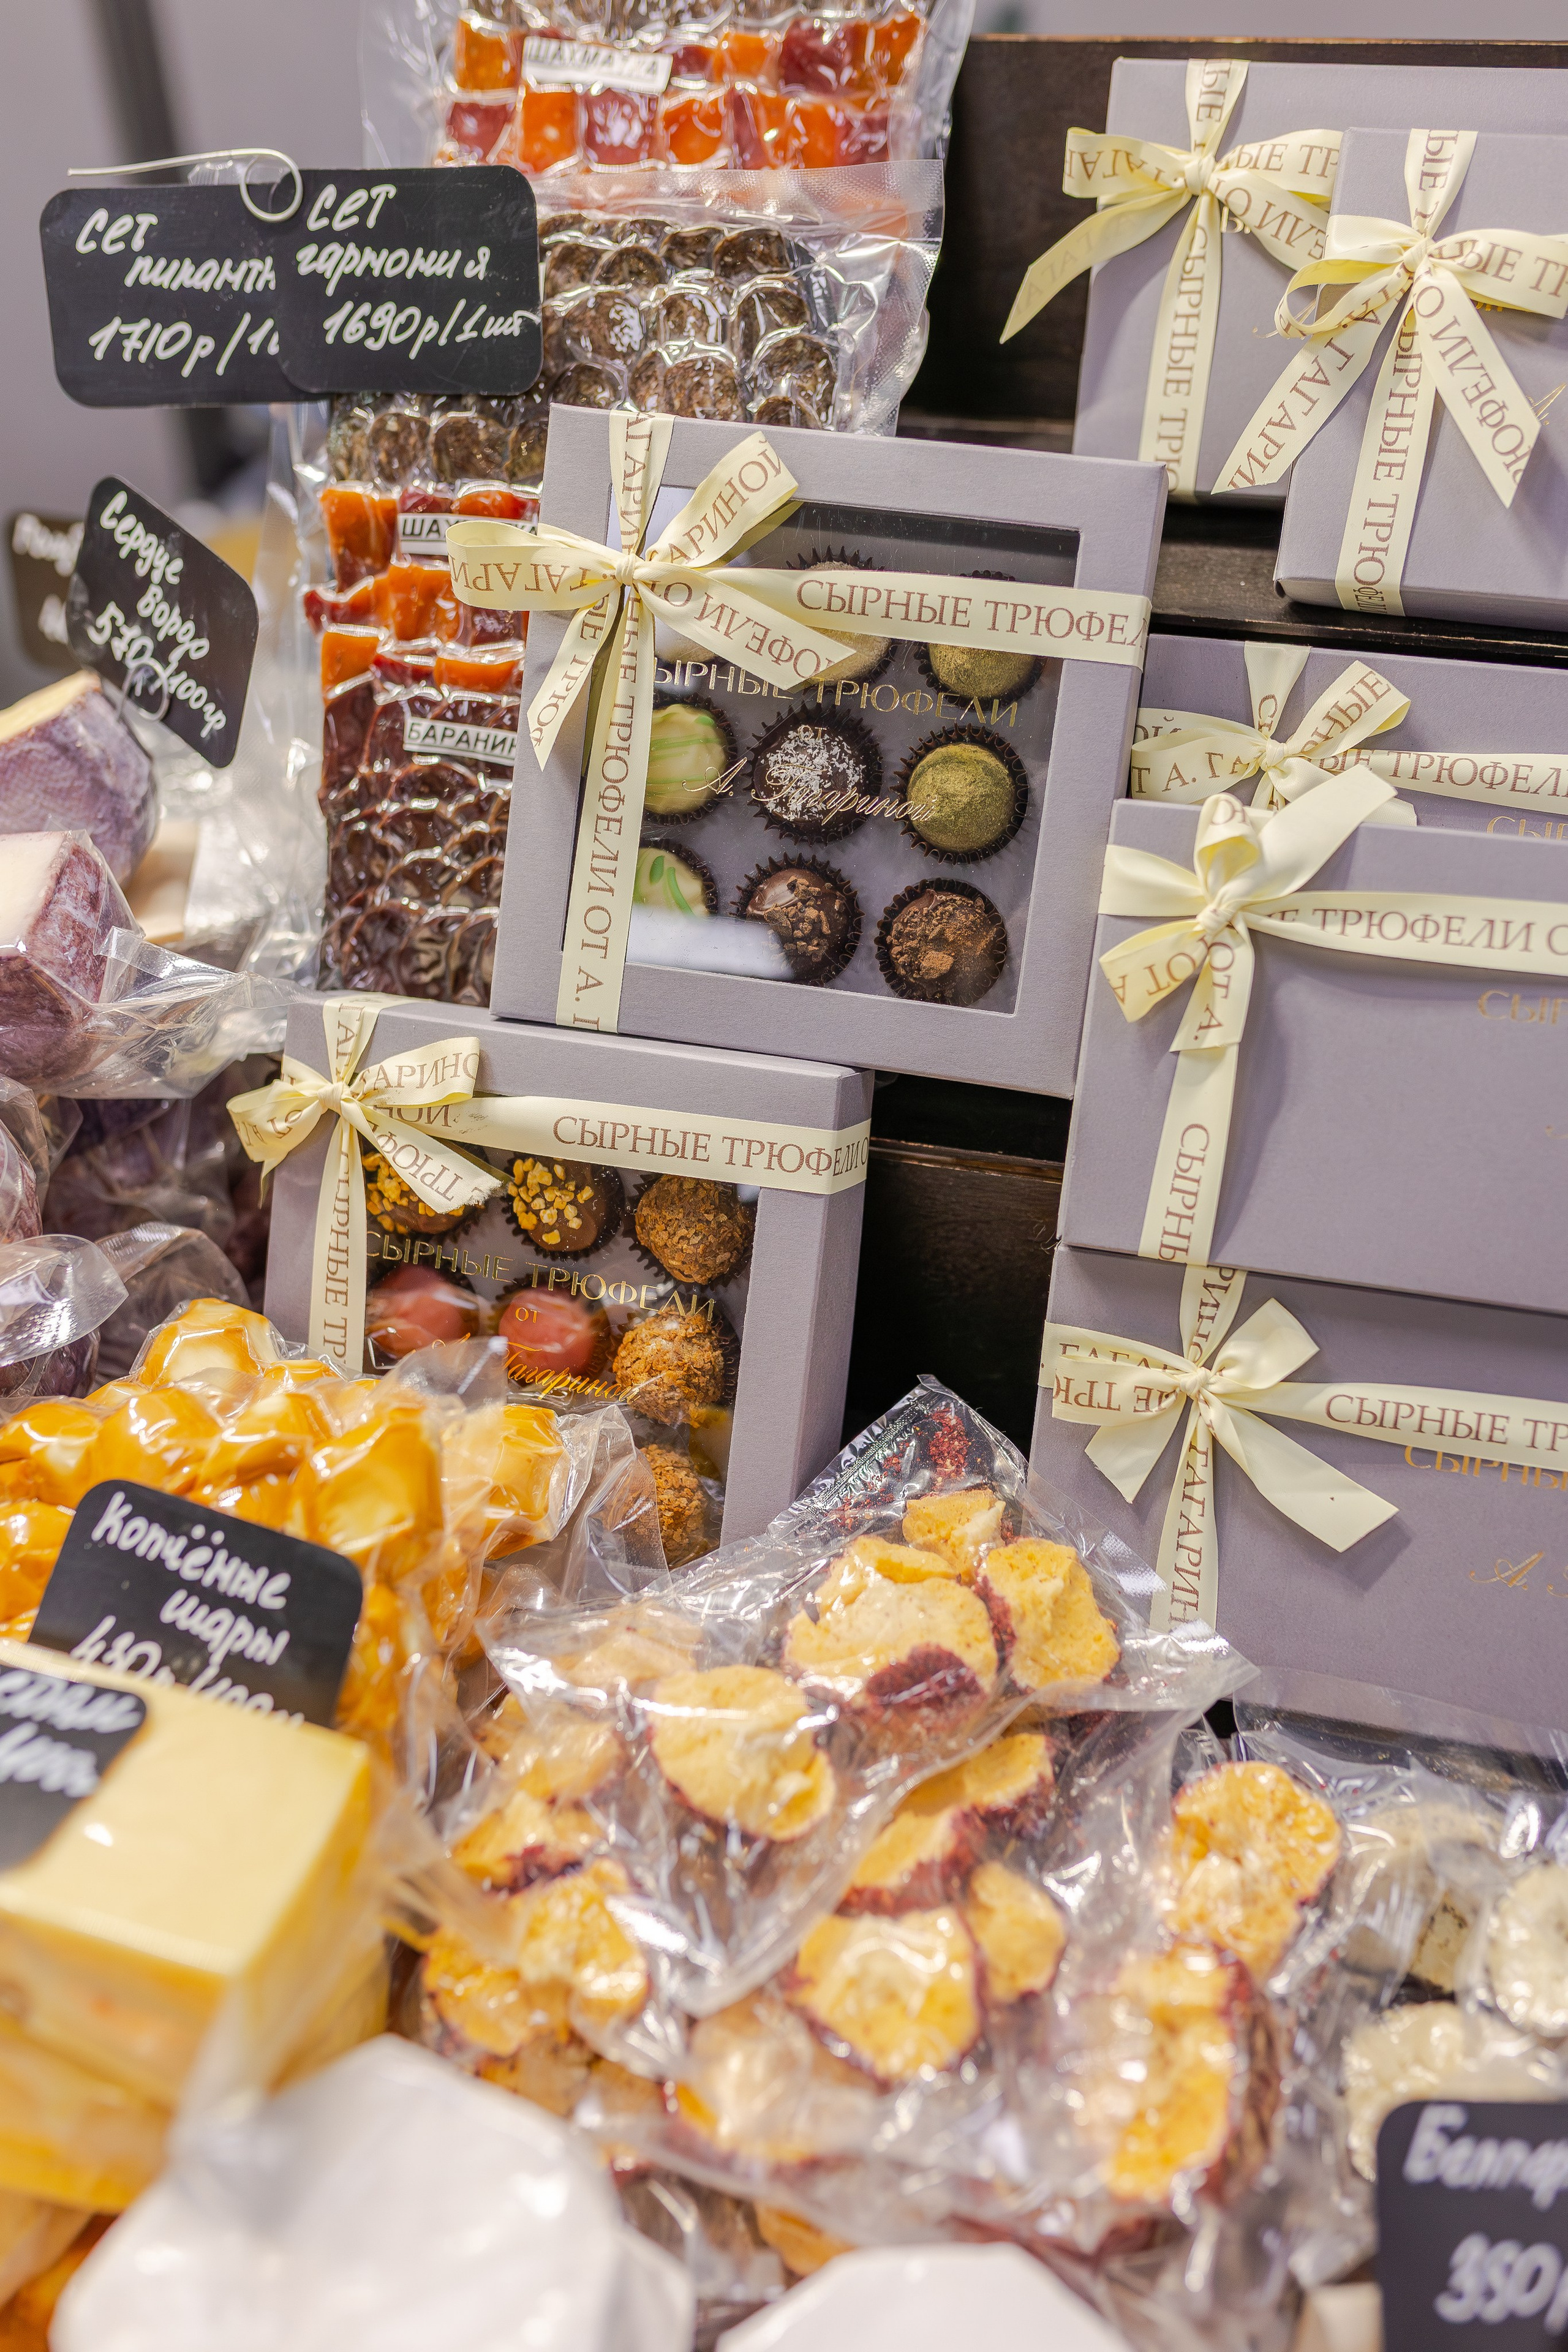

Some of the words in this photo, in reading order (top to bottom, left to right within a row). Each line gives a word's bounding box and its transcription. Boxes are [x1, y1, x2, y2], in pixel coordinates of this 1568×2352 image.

[1196, 59, 1231, 122] ЫЕ
[1419, 129, 1459, 191] ЫЕ
[297, 243, 491, 296] гармония
[100, 491, 184, 585] Сердце
[796, 579, 973, 629] СЫРНЫЕ
[811, 677, 1018, 728] ТРЮФЕЛИ
[587, 695, 635, 896] ТРЮФЕЛИ
[1387, 750, 1568, 797] ТРЮФЕЛ
[581, 905, 612, 959] ОТ
[1311, 908, 1536, 953] ТРЮФЕЛИ
[575, 966, 605, 1001] А.
[1194, 1003, 1224, 1041] А.
[552, 1115, 710, 1163] СЫРНЫЕ
[722, 1136, 860, 1177] ТРЮФЕЛИ
[526, 1262, 716, 1322] ТРЮФЕЛИ
[323, 1317, 348, 1363] ТР
[1325, 1393, 1510, 1445] СЫРНЫЕ
[91, 1491, 292, 1611] Копчёные
[159, 1588, 290, 1666] шары
